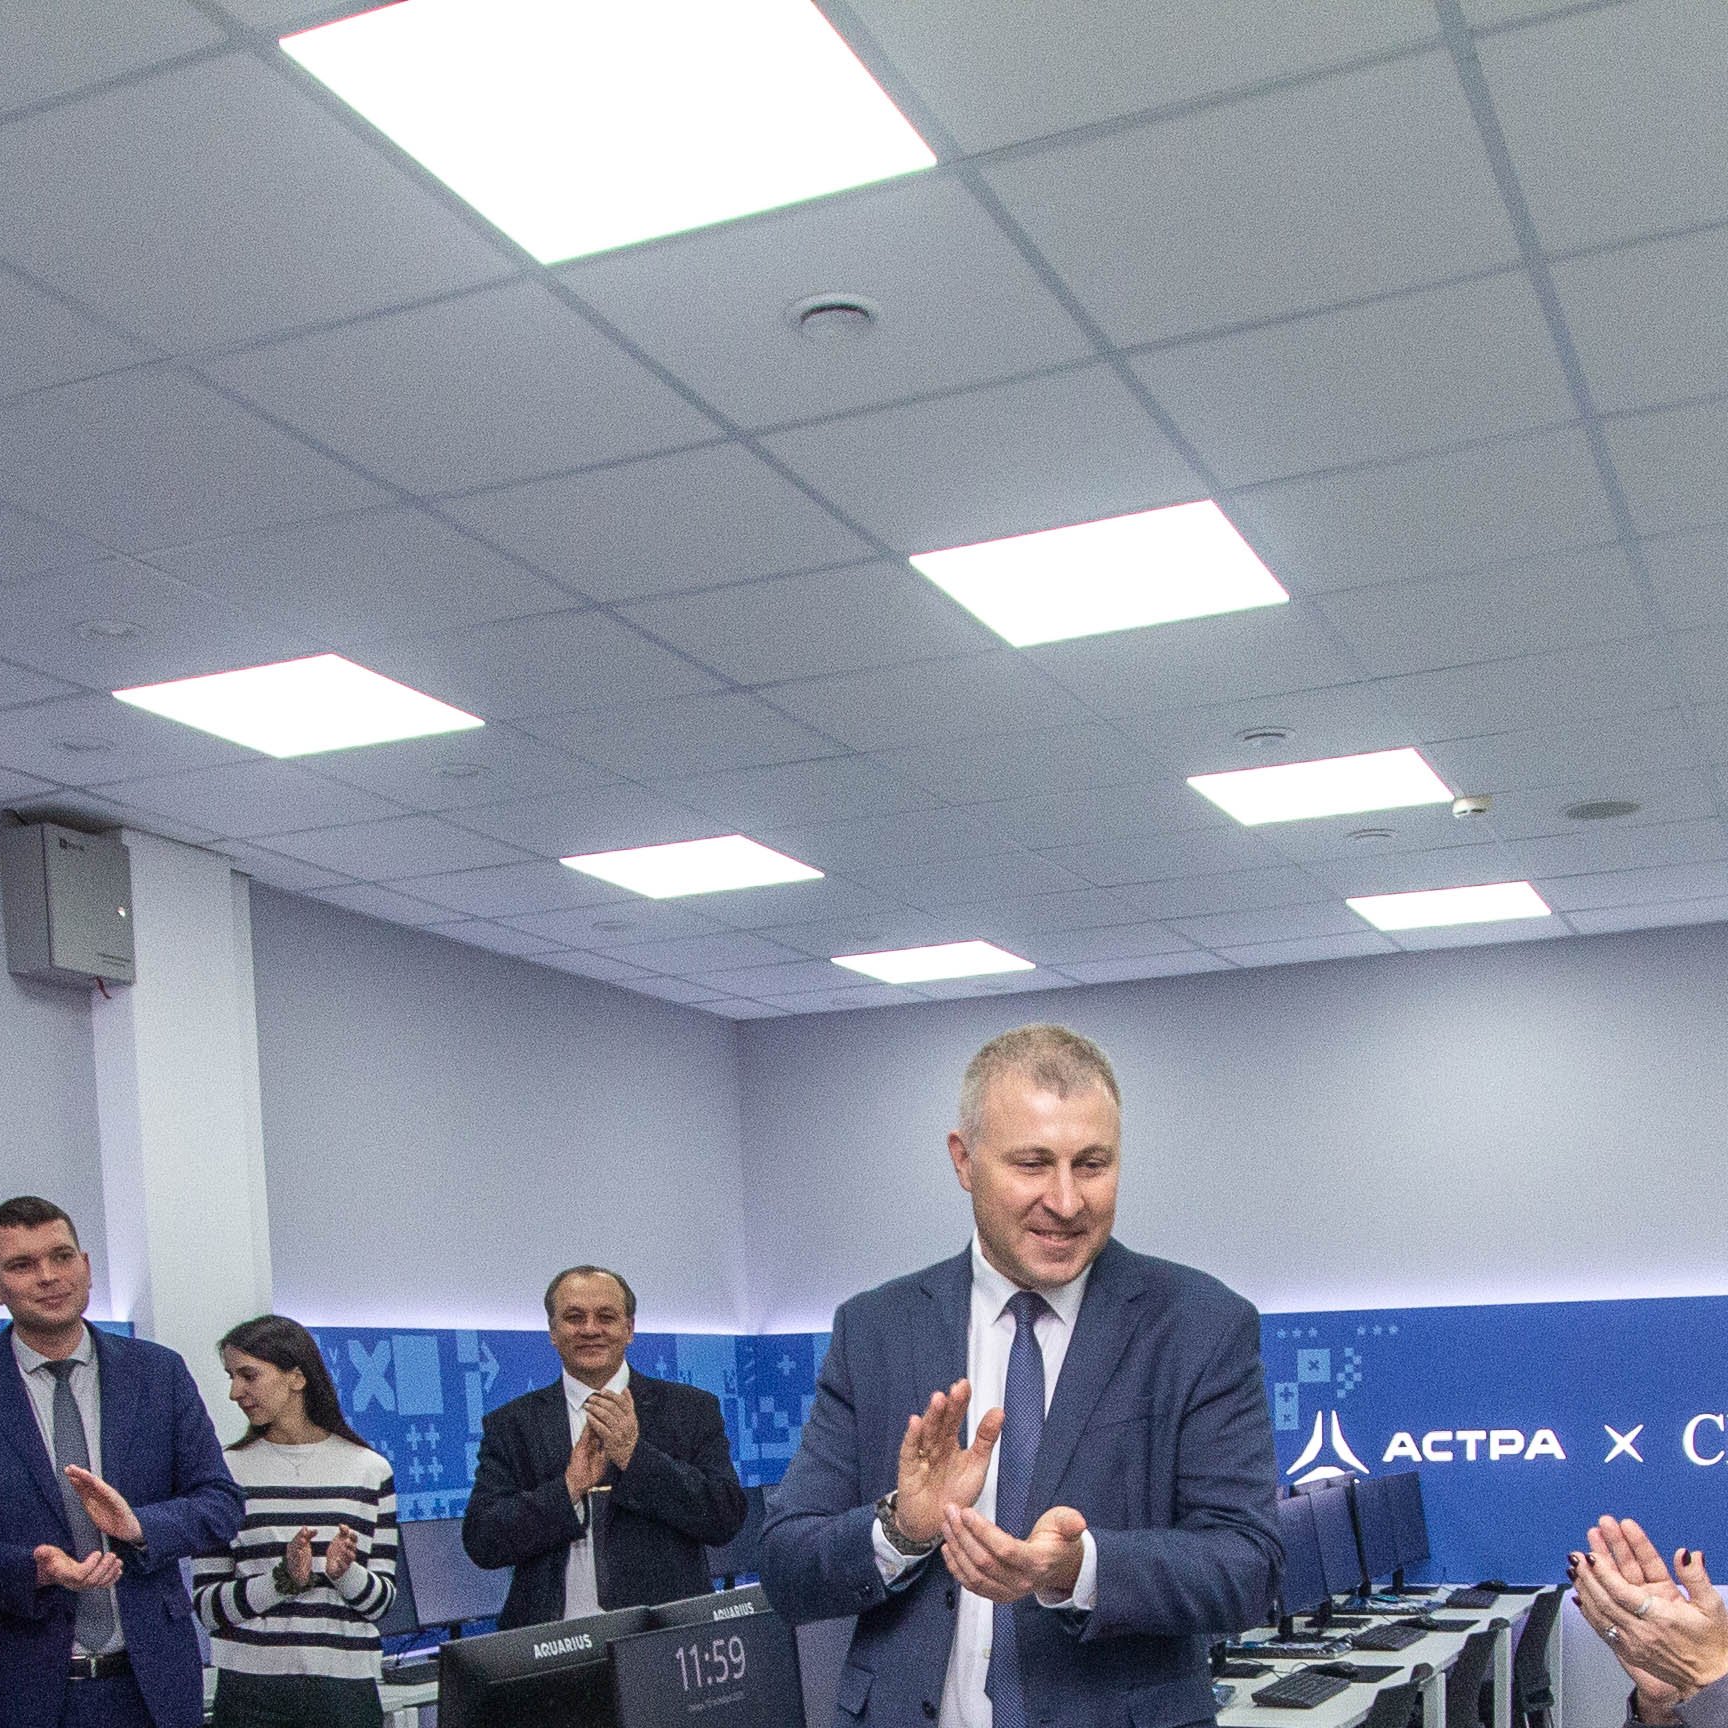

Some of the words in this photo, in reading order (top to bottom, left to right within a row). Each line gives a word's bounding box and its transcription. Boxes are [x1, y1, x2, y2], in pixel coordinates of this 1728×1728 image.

[1382, 1428, 1567, 1462] АСТРА
[712, 1601, 755, 1621] AQUARIUS
[533, 1633, 593, 1660] AQUARIUS
[676, 1635, 746, 1691] 11:59
